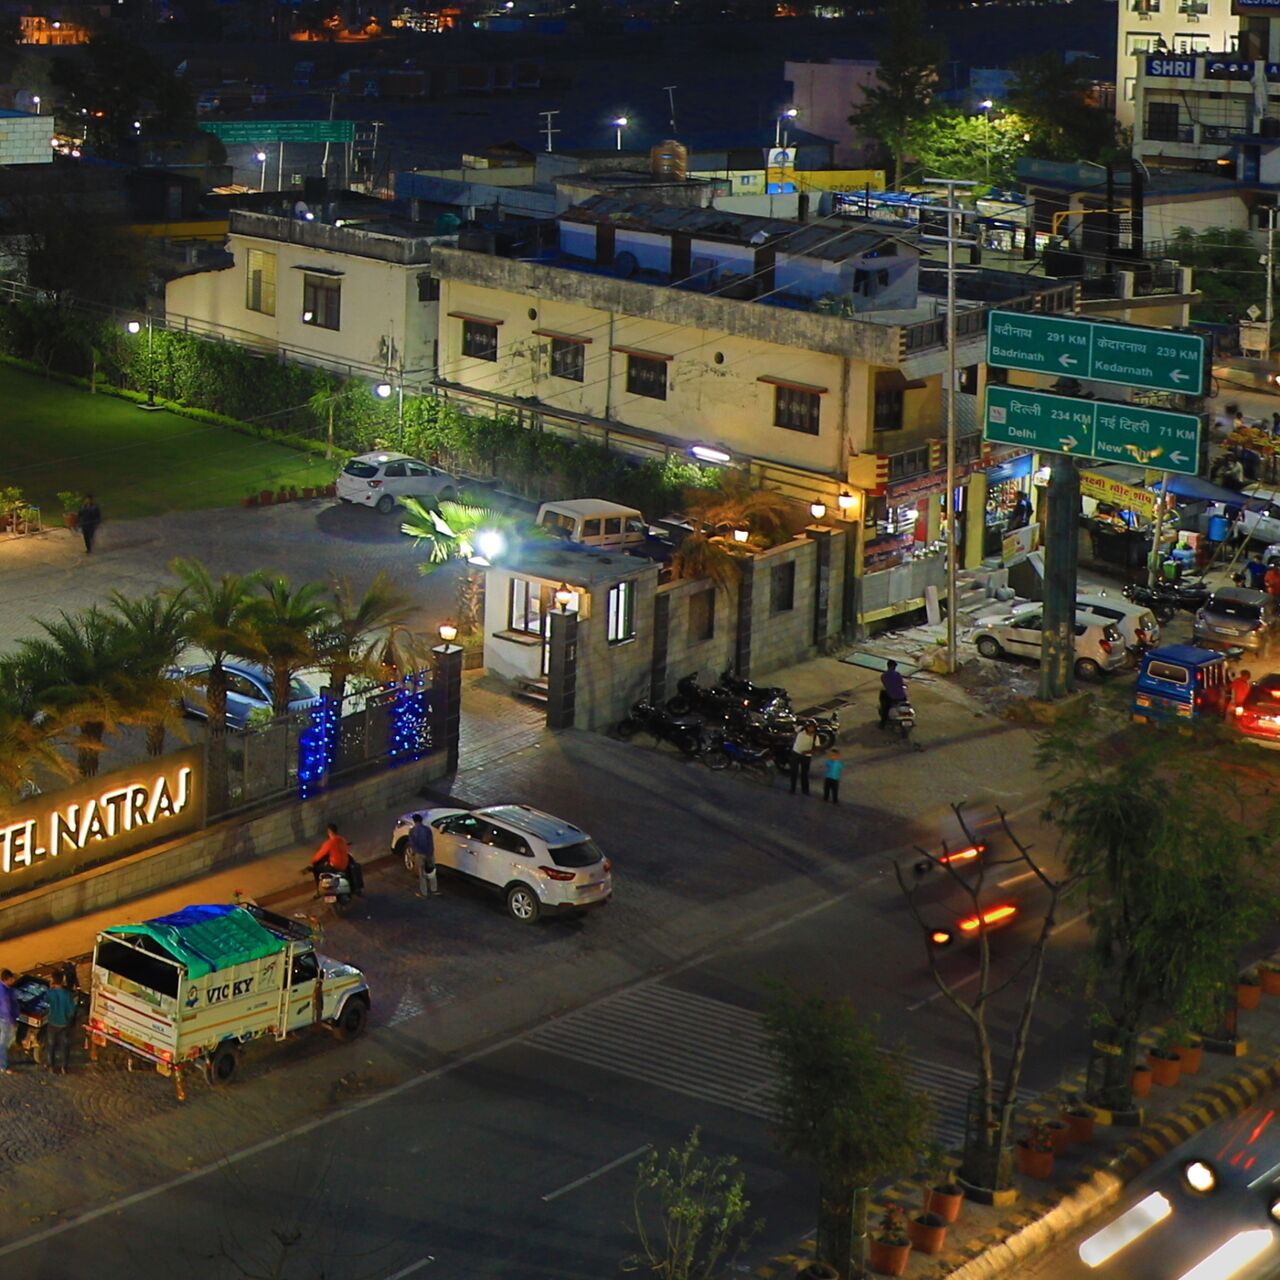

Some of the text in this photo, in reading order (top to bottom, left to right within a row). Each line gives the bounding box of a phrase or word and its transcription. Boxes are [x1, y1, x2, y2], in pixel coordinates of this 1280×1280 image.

[1151, 60, 1192, 77] SHRI
[1046, 332, 1065, 343] 291
[1068, 335, 1087, 346] KM
[992, 346, 1045, 362] Badrinath
[1096, 336, 1198, 361] केदारनाथ 239 KM
[1095, 360, 1153, 377] Kedarnath
[1009, 399, 1042, 417] दिल्ली
[1050, 409, 1070, 421] 234
[1073, 413, 1092, 425] KM
[1008, 426, 1037, 440] Delhi
[1099, 415, 1195, 440] नई टिहरी 71 KM
[1097, 441, 1124, 453] New
[50, 767, 192, 857] NATRAJ
[206, 977, 254, 1004] VICKY
